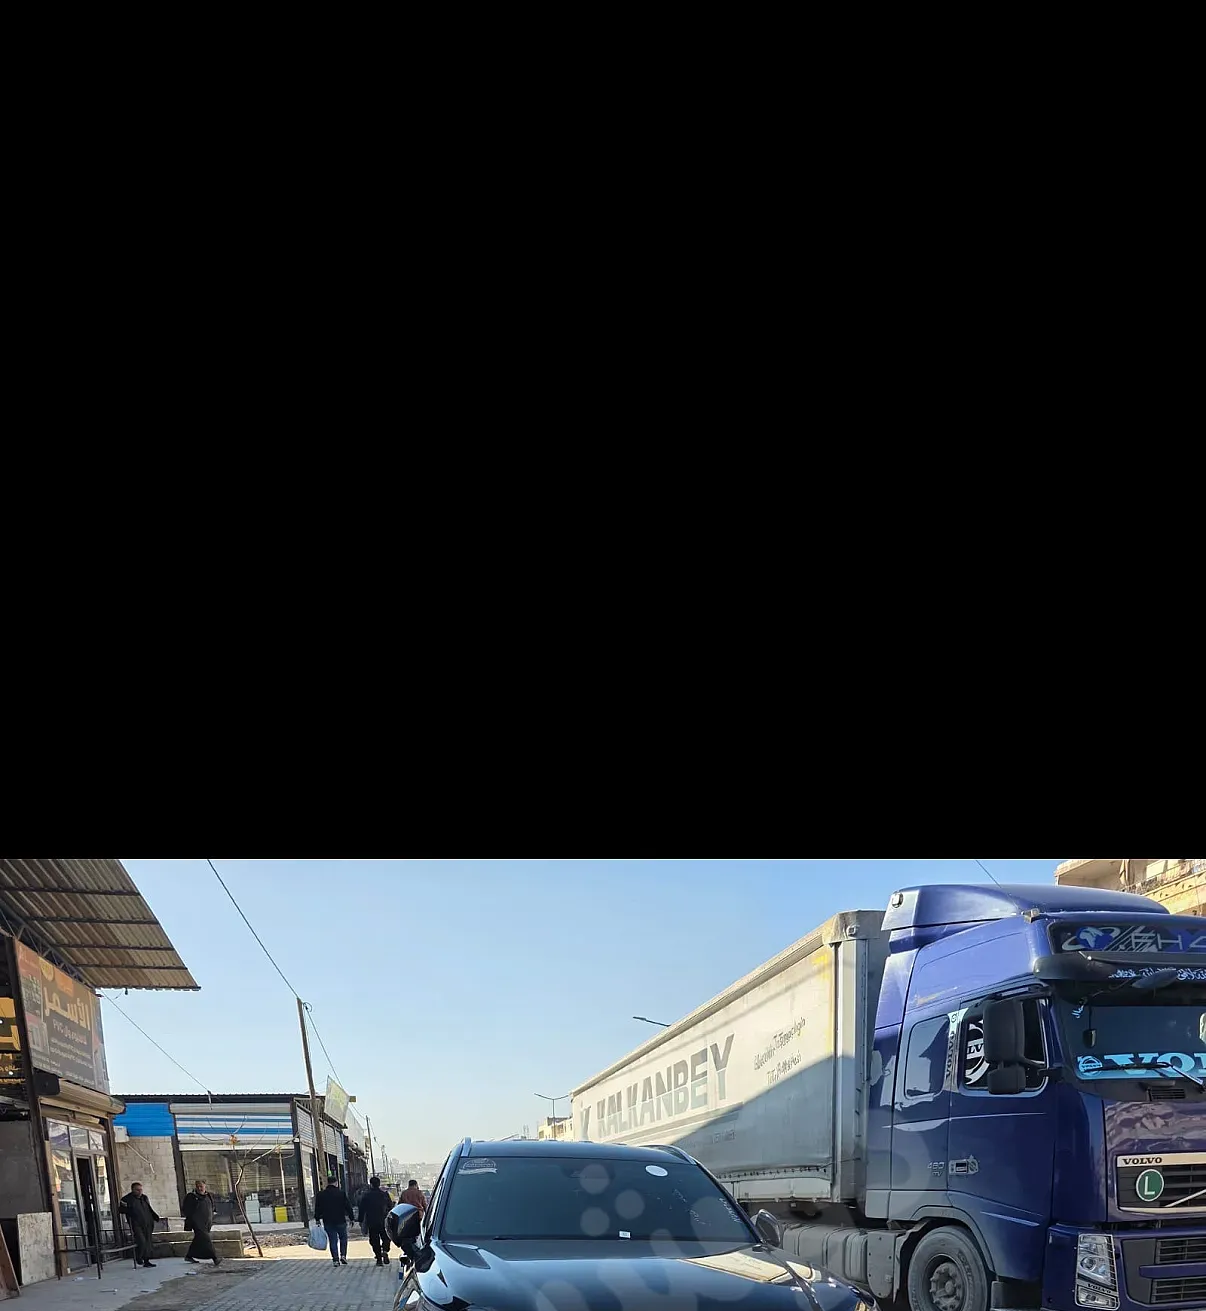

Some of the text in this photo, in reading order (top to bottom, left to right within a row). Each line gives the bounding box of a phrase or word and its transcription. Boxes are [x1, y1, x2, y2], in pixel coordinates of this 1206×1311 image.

[596, 1033, 735, 1138] KALKANBEY
[1122, 1157, 1163, 1165] VOLVO
[1144, 1176, 1155, 1196] L
[1087, 1283, 1112, 1294] VOLVO
